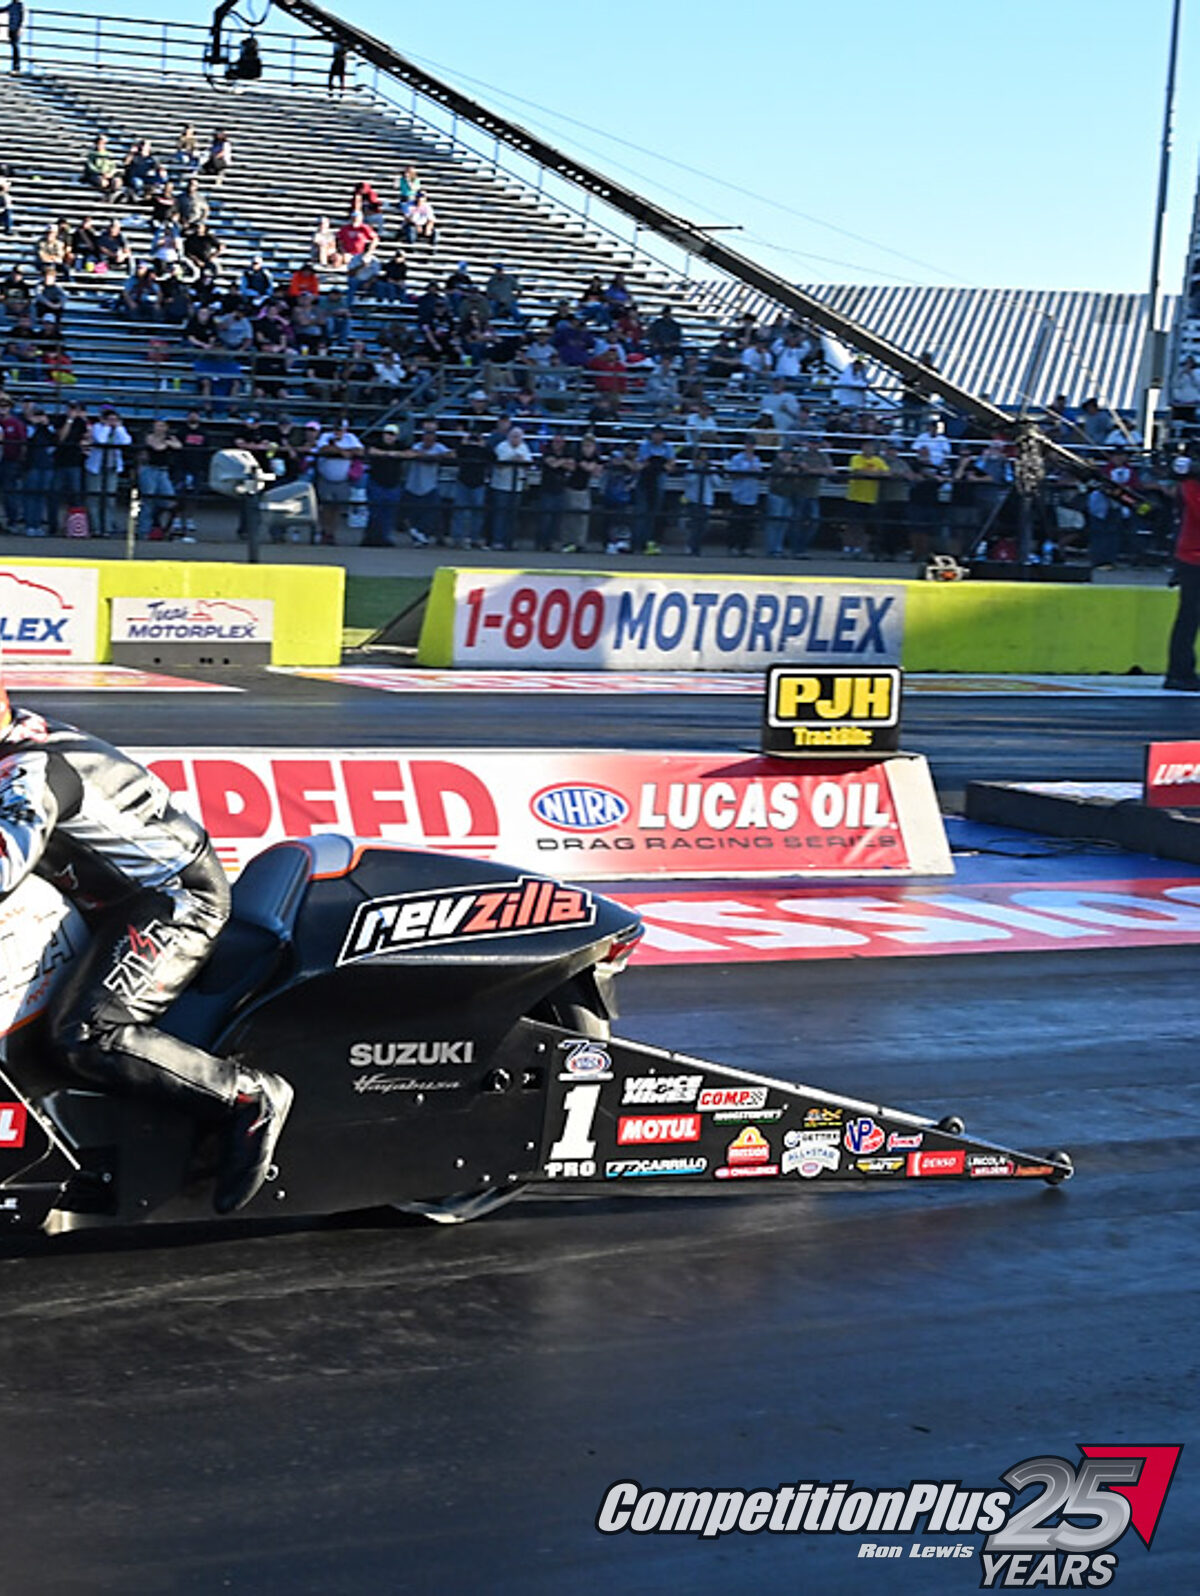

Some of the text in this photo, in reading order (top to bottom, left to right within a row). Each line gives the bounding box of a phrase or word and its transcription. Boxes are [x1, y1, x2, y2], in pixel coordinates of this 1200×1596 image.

[146, 600, 189, 622] Texas
[463, 587, 894, 654] 1-800 MOTORPLEX
[127, 624, 257, 639] MOTORPLEX
[777, 677, 891, 719] PJH
[546, 788, 624, 828] NHRA
[638, 782, 890, 830] LUCAS OIL
[537, 835, 897, 851] DRAG RACING SERIES
[354, 881, 585, 951] revzilla
[349, 1041, 474, 1067] SUZUKI
[700, 1091, 751, 1105] COMP
[550, 1084, 601, 1160] 1
[620, 1117, 696, 1141] MOTUL
[847, 1119, 873, 1152] VP
[544, 1160, 596, 1179] PRO
[921, 1156, 957, 1170] DENSO
